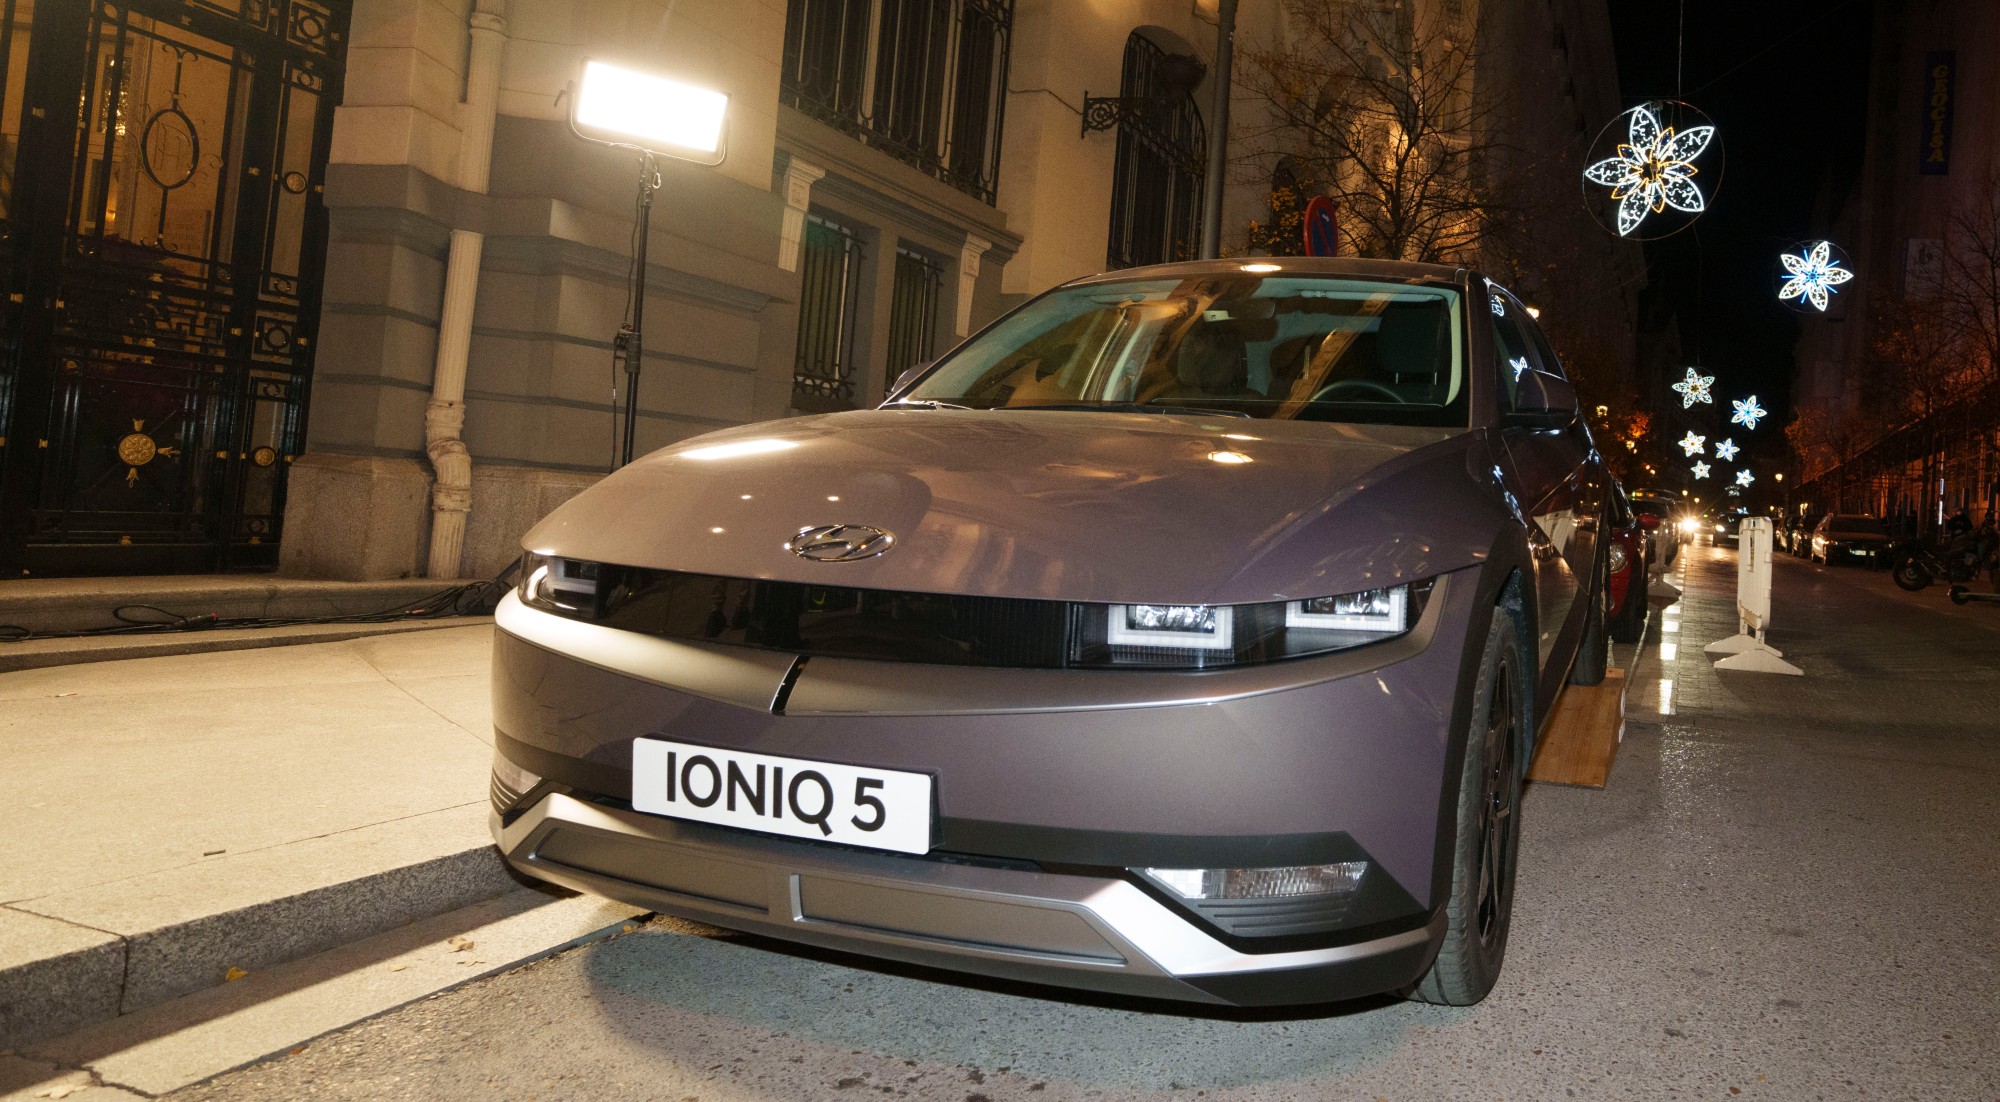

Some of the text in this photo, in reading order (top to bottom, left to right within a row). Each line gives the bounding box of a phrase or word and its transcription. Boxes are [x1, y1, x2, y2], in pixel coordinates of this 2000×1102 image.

[1927, 64, 1949, 162] GEOCISA
[667, 751, 886, 837] IONIQ 5
